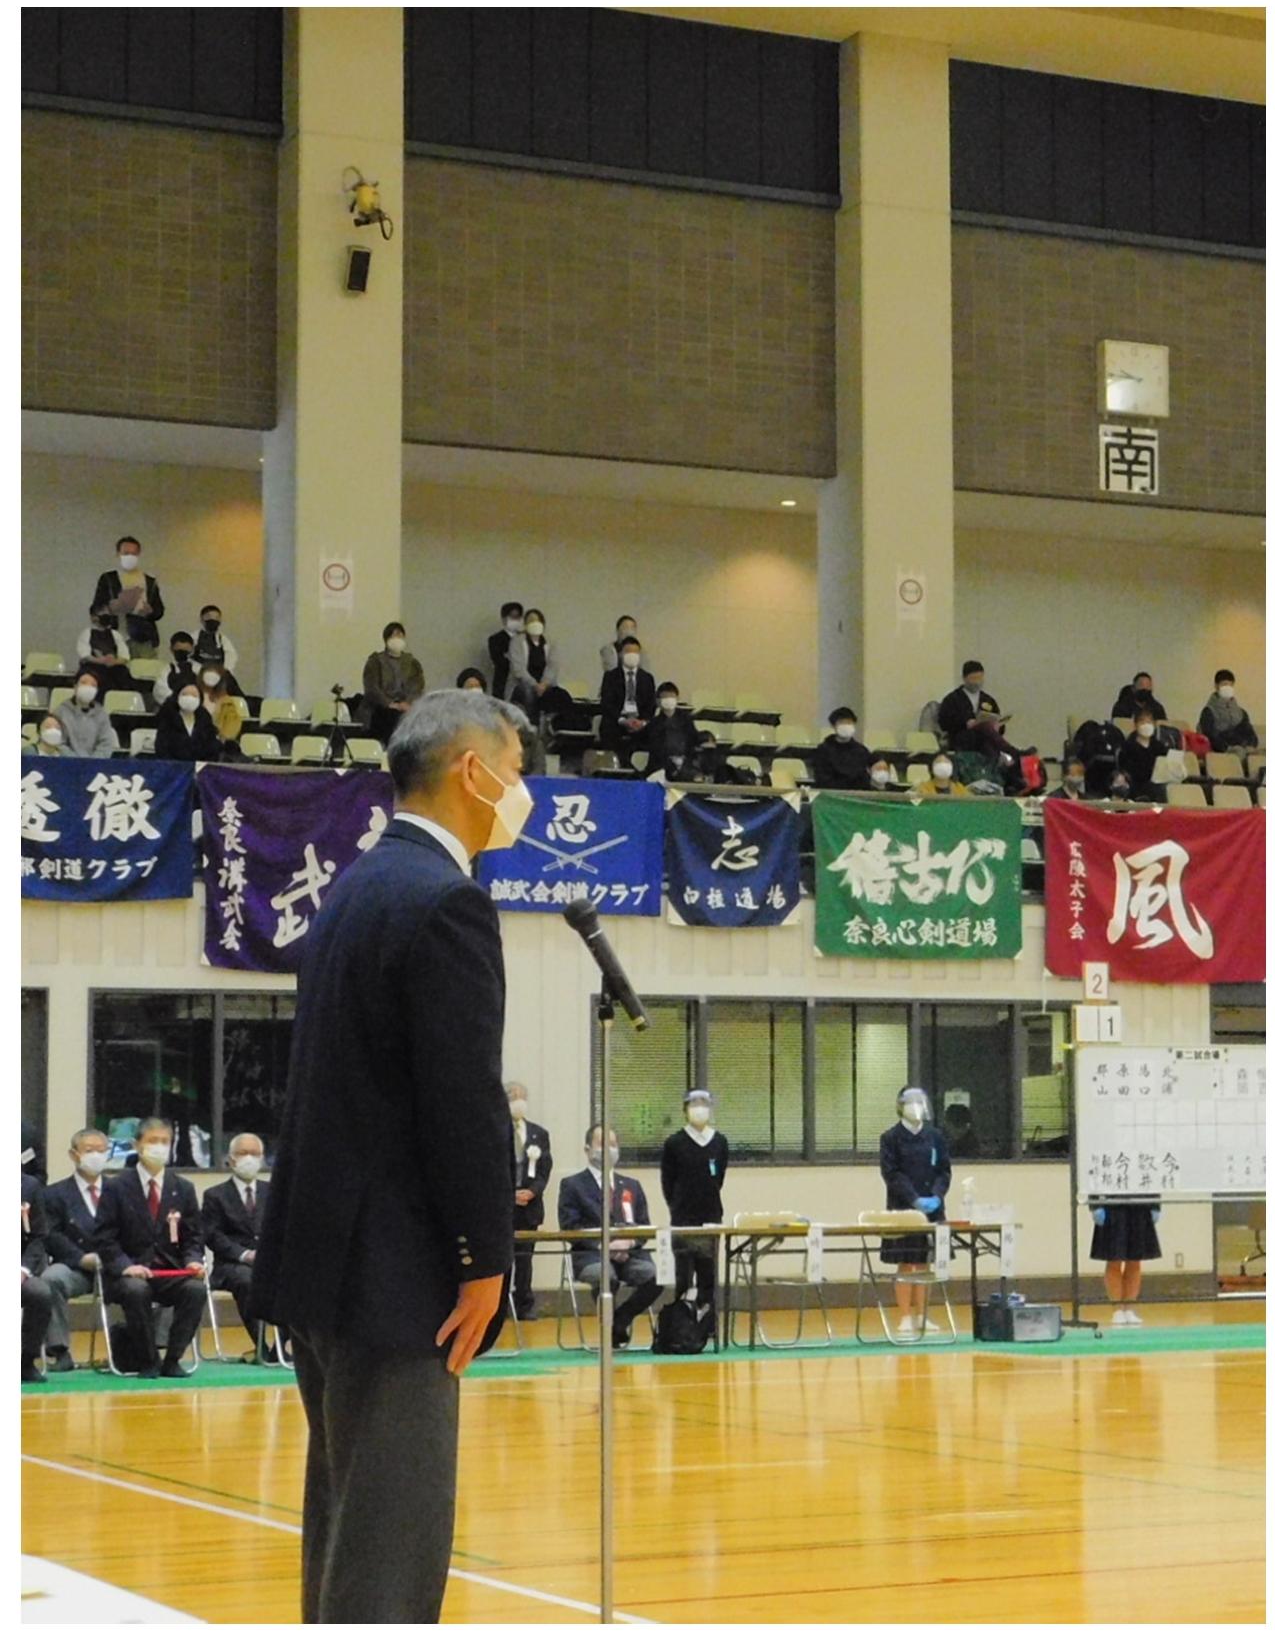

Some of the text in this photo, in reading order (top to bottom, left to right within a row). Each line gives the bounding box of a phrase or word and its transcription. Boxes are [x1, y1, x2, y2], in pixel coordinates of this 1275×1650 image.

[1104, 427, 1156, 491] 南
[546, 794, 597, 844] 忍
[1106, 839, 1214, 959] 風
[842, 914, 998, 947] 奈良心剣道場
[1092, 975, 1103, 994] 2
